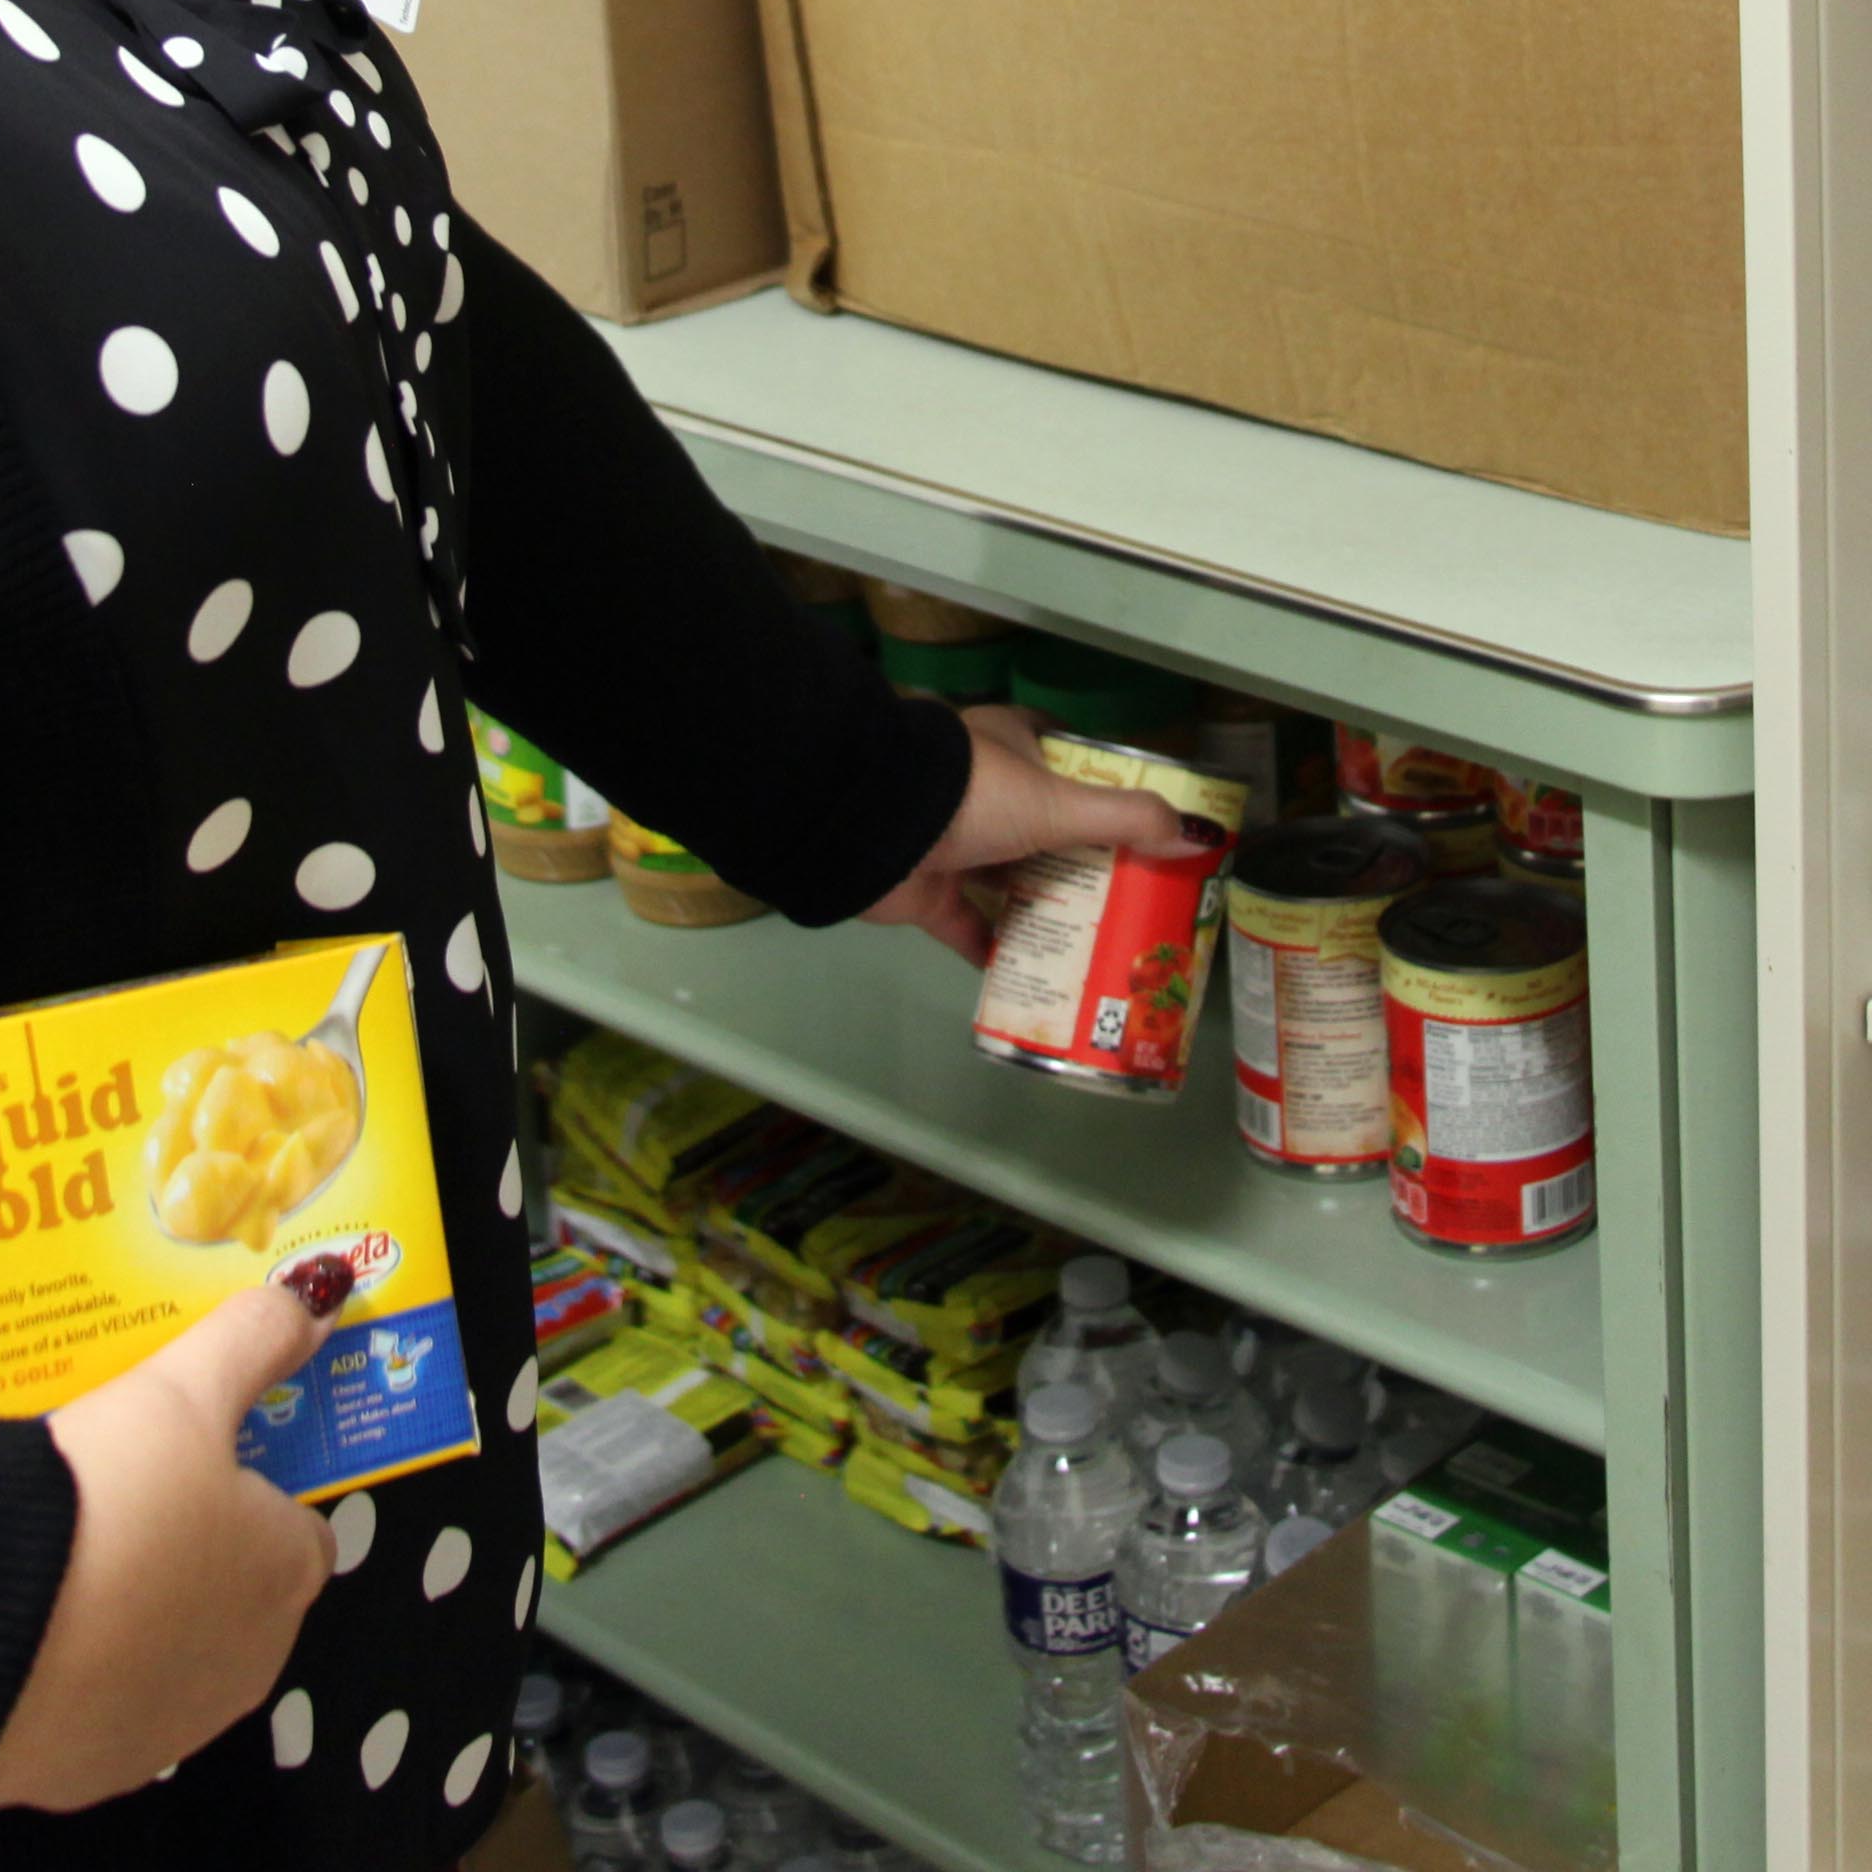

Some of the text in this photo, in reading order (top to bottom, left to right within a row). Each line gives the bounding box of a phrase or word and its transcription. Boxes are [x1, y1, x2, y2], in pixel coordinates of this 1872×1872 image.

[29, 1271, 93, 1299] favorite,
[14, 1291, 122, 1332] unmistakable,
[32, 1336, 49, 1354] of
[52, 1336, 63, 1349] a
[66, 1324, 99, 1346] kind
[12, 1356, 75, 1390] GOLD!
[331, 1349, 368, 1376] ADD
